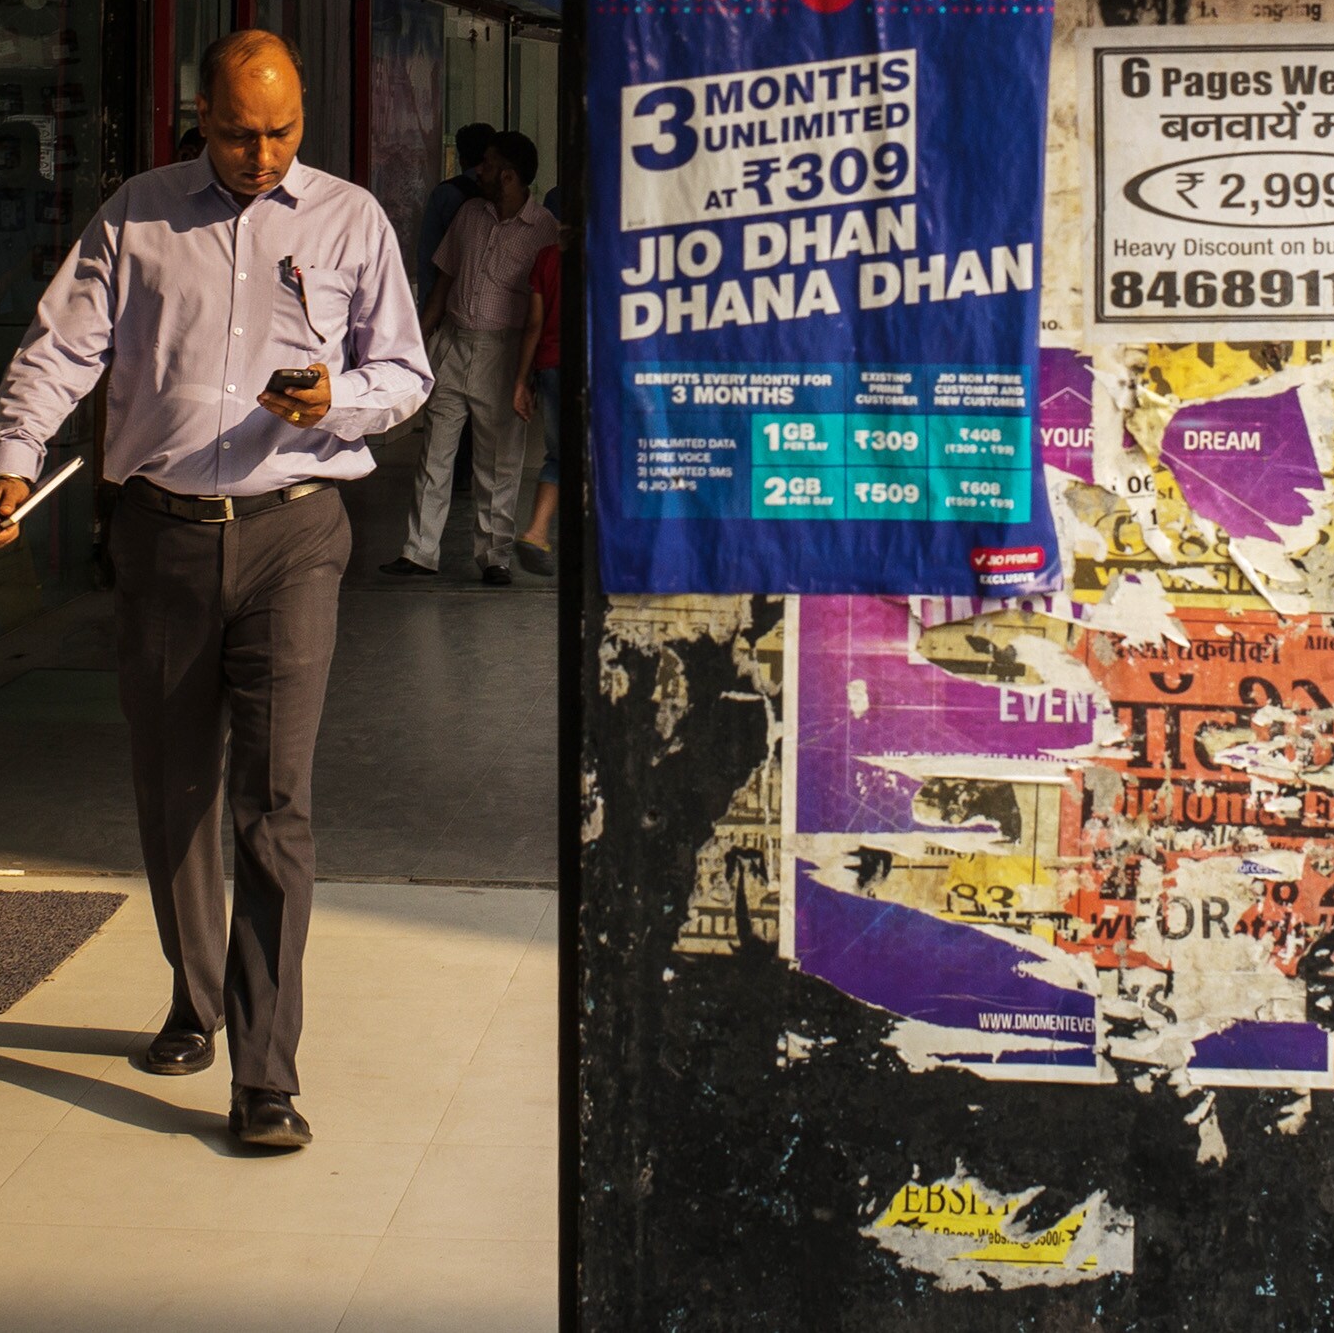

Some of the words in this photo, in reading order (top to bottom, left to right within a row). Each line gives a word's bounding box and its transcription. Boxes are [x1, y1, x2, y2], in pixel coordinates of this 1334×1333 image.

[1121, 56, 1151, 98] 6
[1162, 67, 1273, 100] Pages
[632, 86, 698, 170] 3
[705, 59, 910, 116] MONTHS
[705, 103, 909, 152] UNLIMITED
[1160, 100, 1306, 141] बनवायें
[705, 189, 737, 211] AT
[743, 142, 909, 206] ₹309
[1176, 172, 1205, 209] ₹
[621, 228, 722, 287] JIO
[743, 203, 916, 271] DHAN
[1114, 238, 1176, 260] Heavy
[1184, 237, 1274, 257] Discount
[1281, 240, 1305, 256] on
[621, 269, 840, 340] DHANA
[859, 243, 1033, 310] DHAN
[635, 373, 700, 385] BENEFITS
[703, 374, 747, 385] EVERY
[750, 374, 800, 385] MONTH
[804, 375, 832, 386] FOR
[672, 386, 687, 404] 3
[693, 386, 795, 405] MONTHS
[783, 423, 816, 441] GB
[1184, 429, 1261, 452] DREAM
[764, 477, 787, 506] 2
[789, 478, 822, 495] GB
